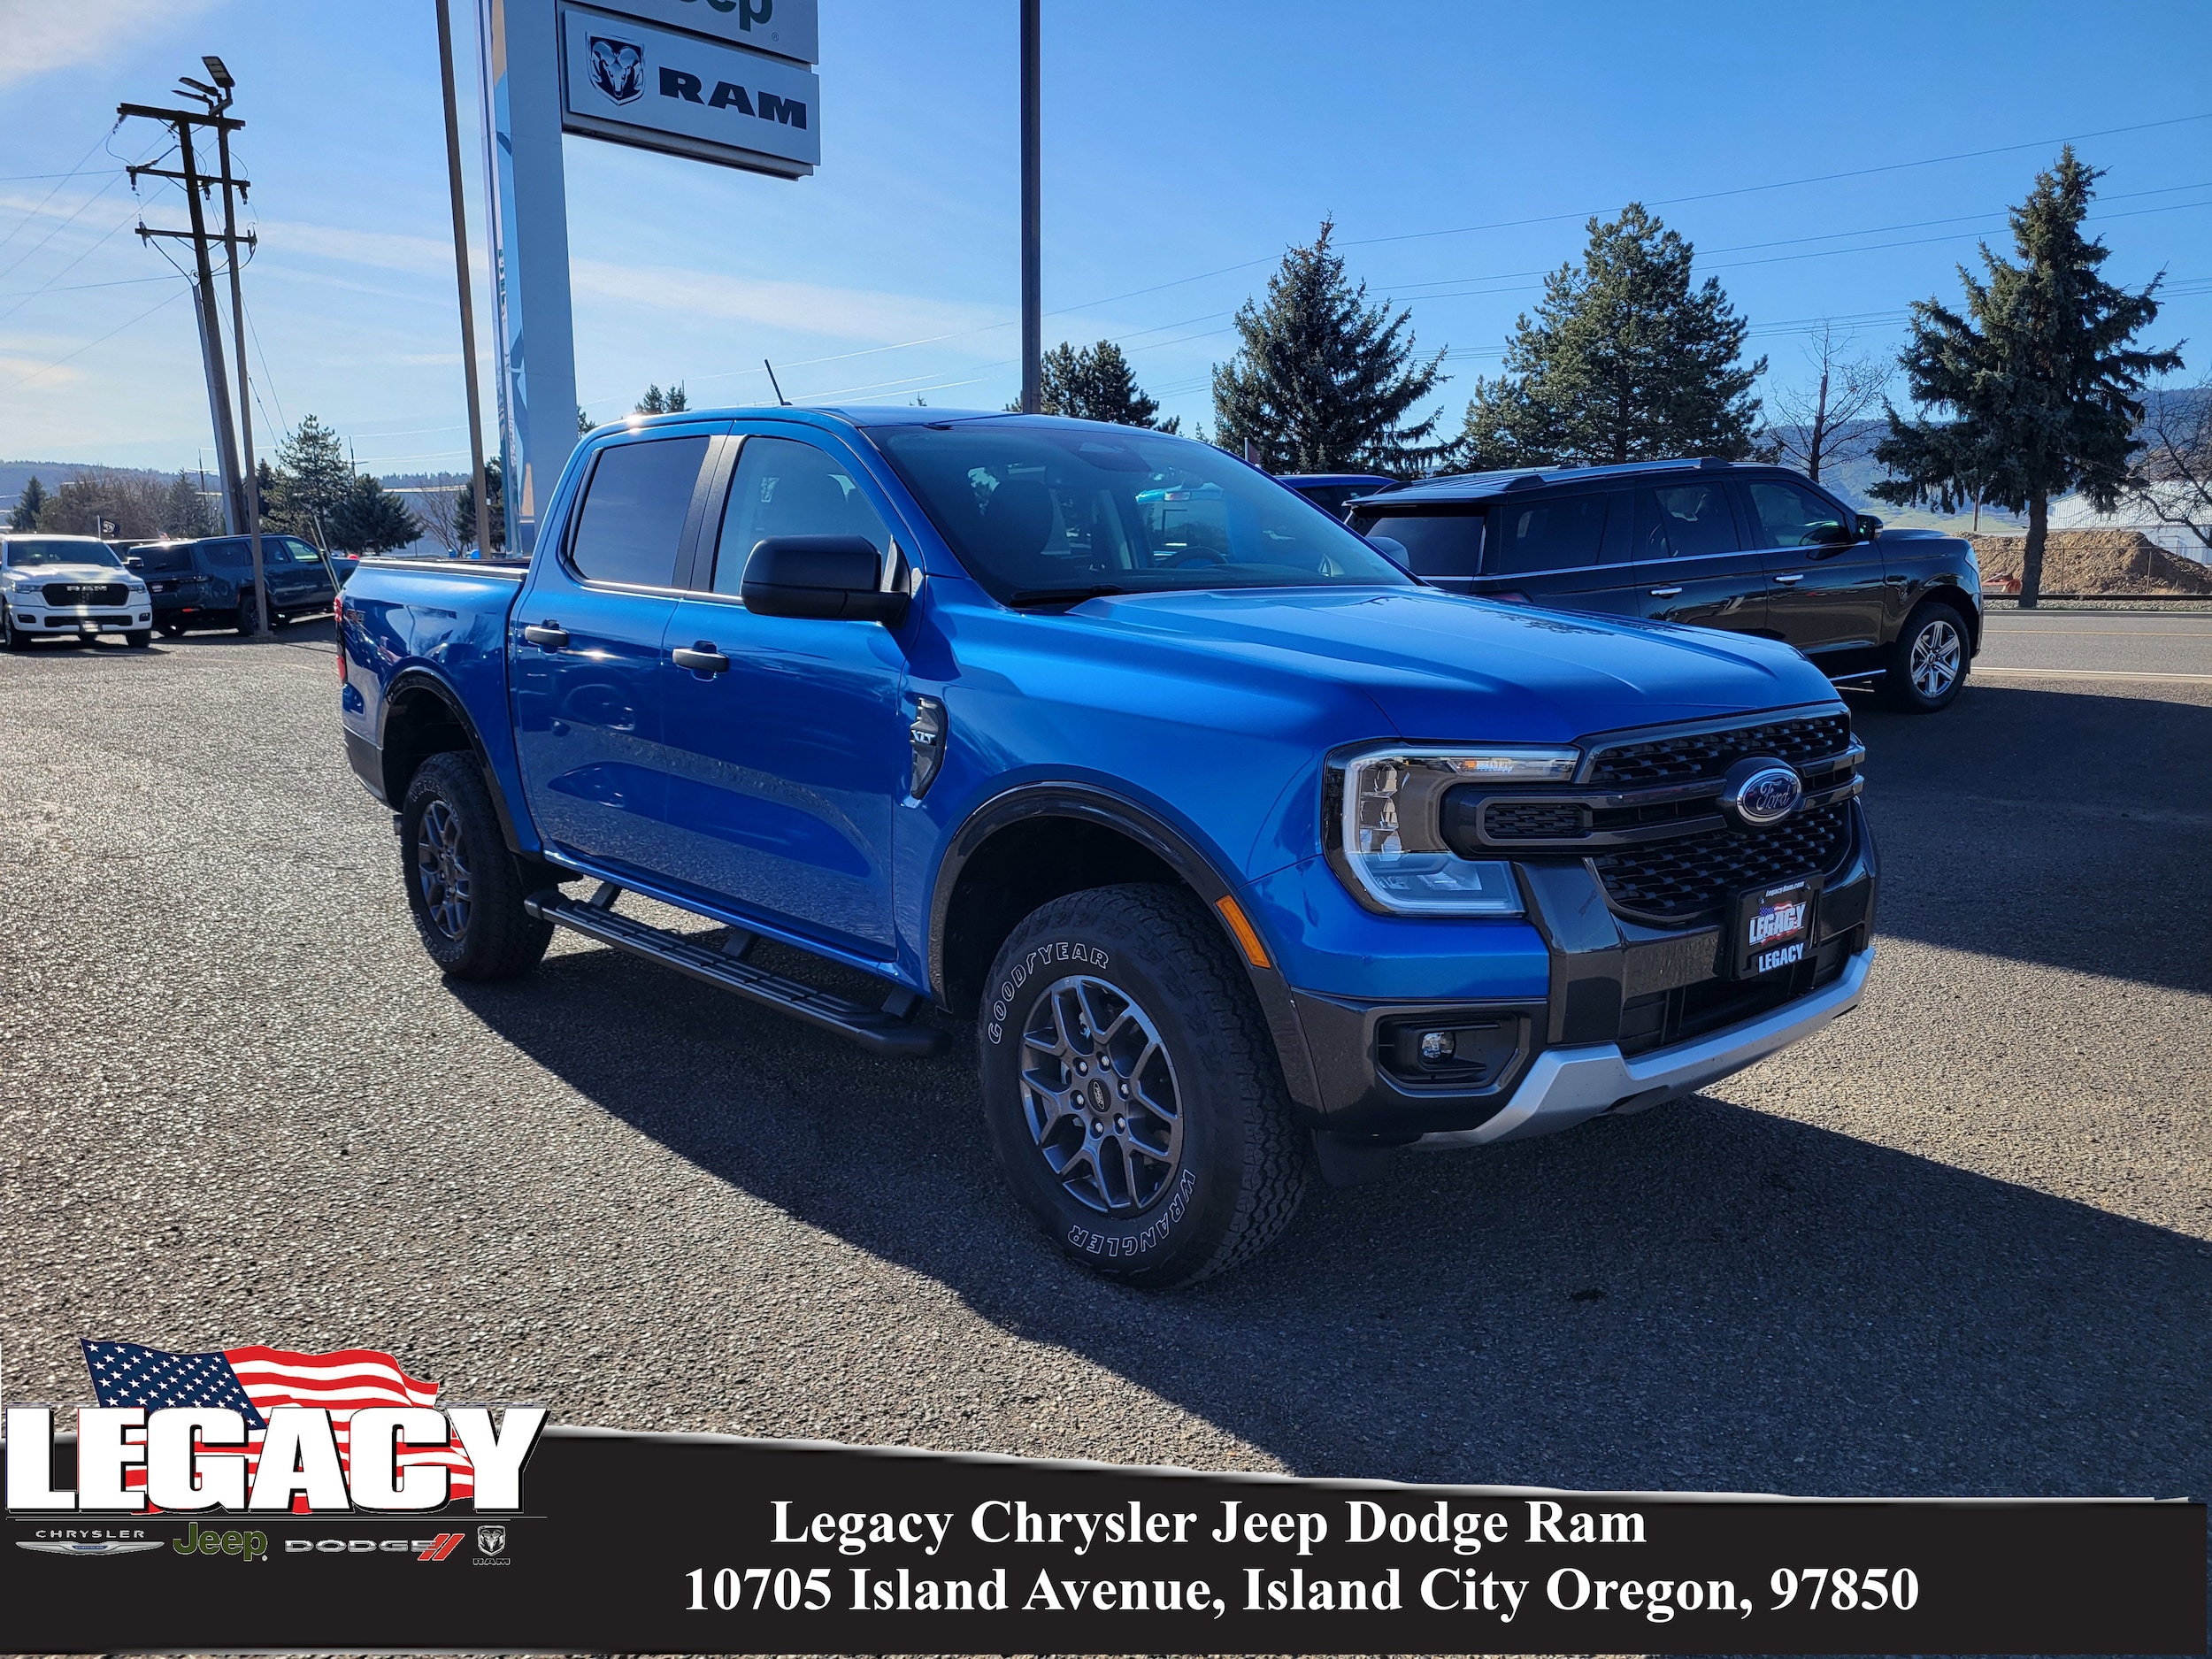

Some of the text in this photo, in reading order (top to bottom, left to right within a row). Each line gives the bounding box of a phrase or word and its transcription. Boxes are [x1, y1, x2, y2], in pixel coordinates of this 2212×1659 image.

[659, 66, 807, 130] RAM
[910, 729, 936, 744] XLT
[1756, 780, 1791, 811] Ford
[1749, 903, 1807, 944] LEGACY
[1758, 942, 1805, 972] LEGACY
[988, 941, 1110, 1045] GOODYEAR
[1067, 1169, 1196, 1257] WRANGLER
